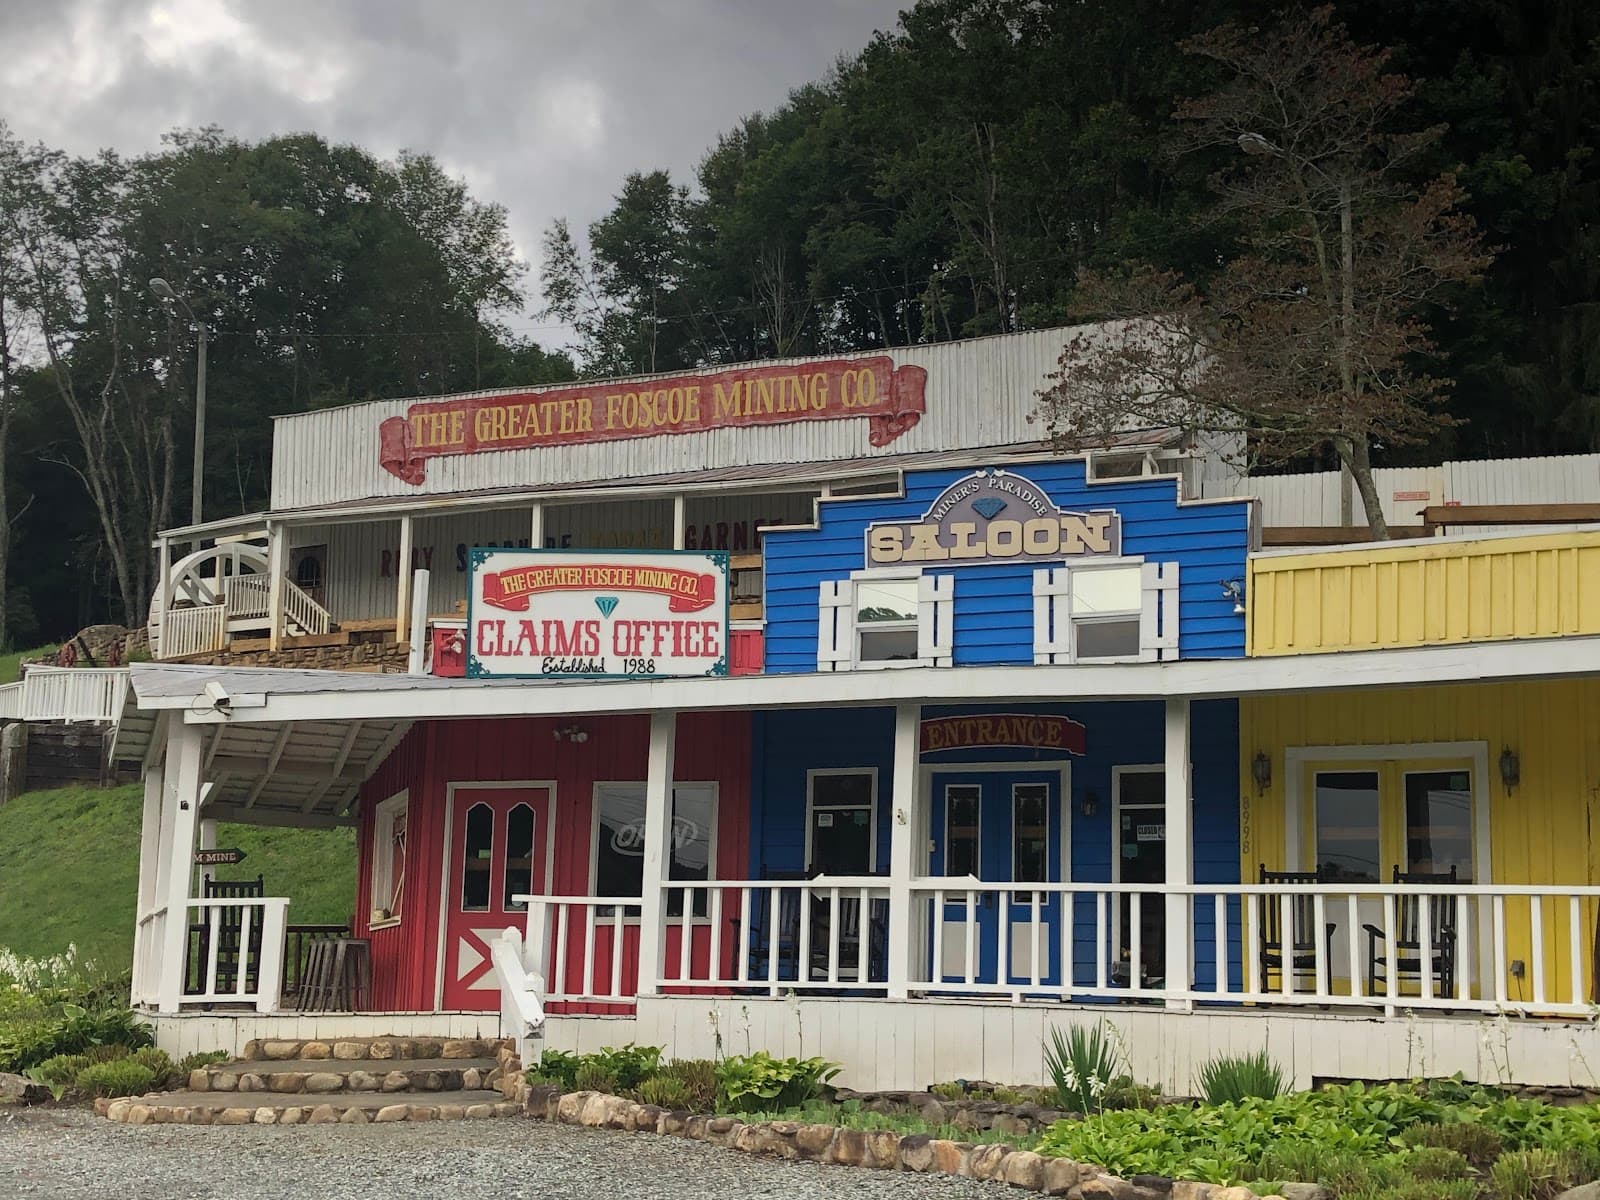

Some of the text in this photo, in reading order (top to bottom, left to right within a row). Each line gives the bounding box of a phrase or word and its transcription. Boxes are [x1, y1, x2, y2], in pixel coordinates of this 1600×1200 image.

[412, 410, 466, 449] THE
[474, 399, 593, 442] GREATER
[606, 385, 700, 431] FOSCOE
[712, 373, 829, 419] MINING
[932, 477, 1048, 522] MINER'S PARADISE
[871, 514, 1112, 563] SALOON
[500, 567, 700, 597] THE GREATER FOSCOE MINING CO.
[476, 620, 720, 658] CLAIMS OFFICE
[541, 656, 656, 675] Established 1988
[926, 718, 1063, 749] ENTRANCE
[1242, 796, 1250, 854] 8998
[206, 853, 237, 862] MINE
